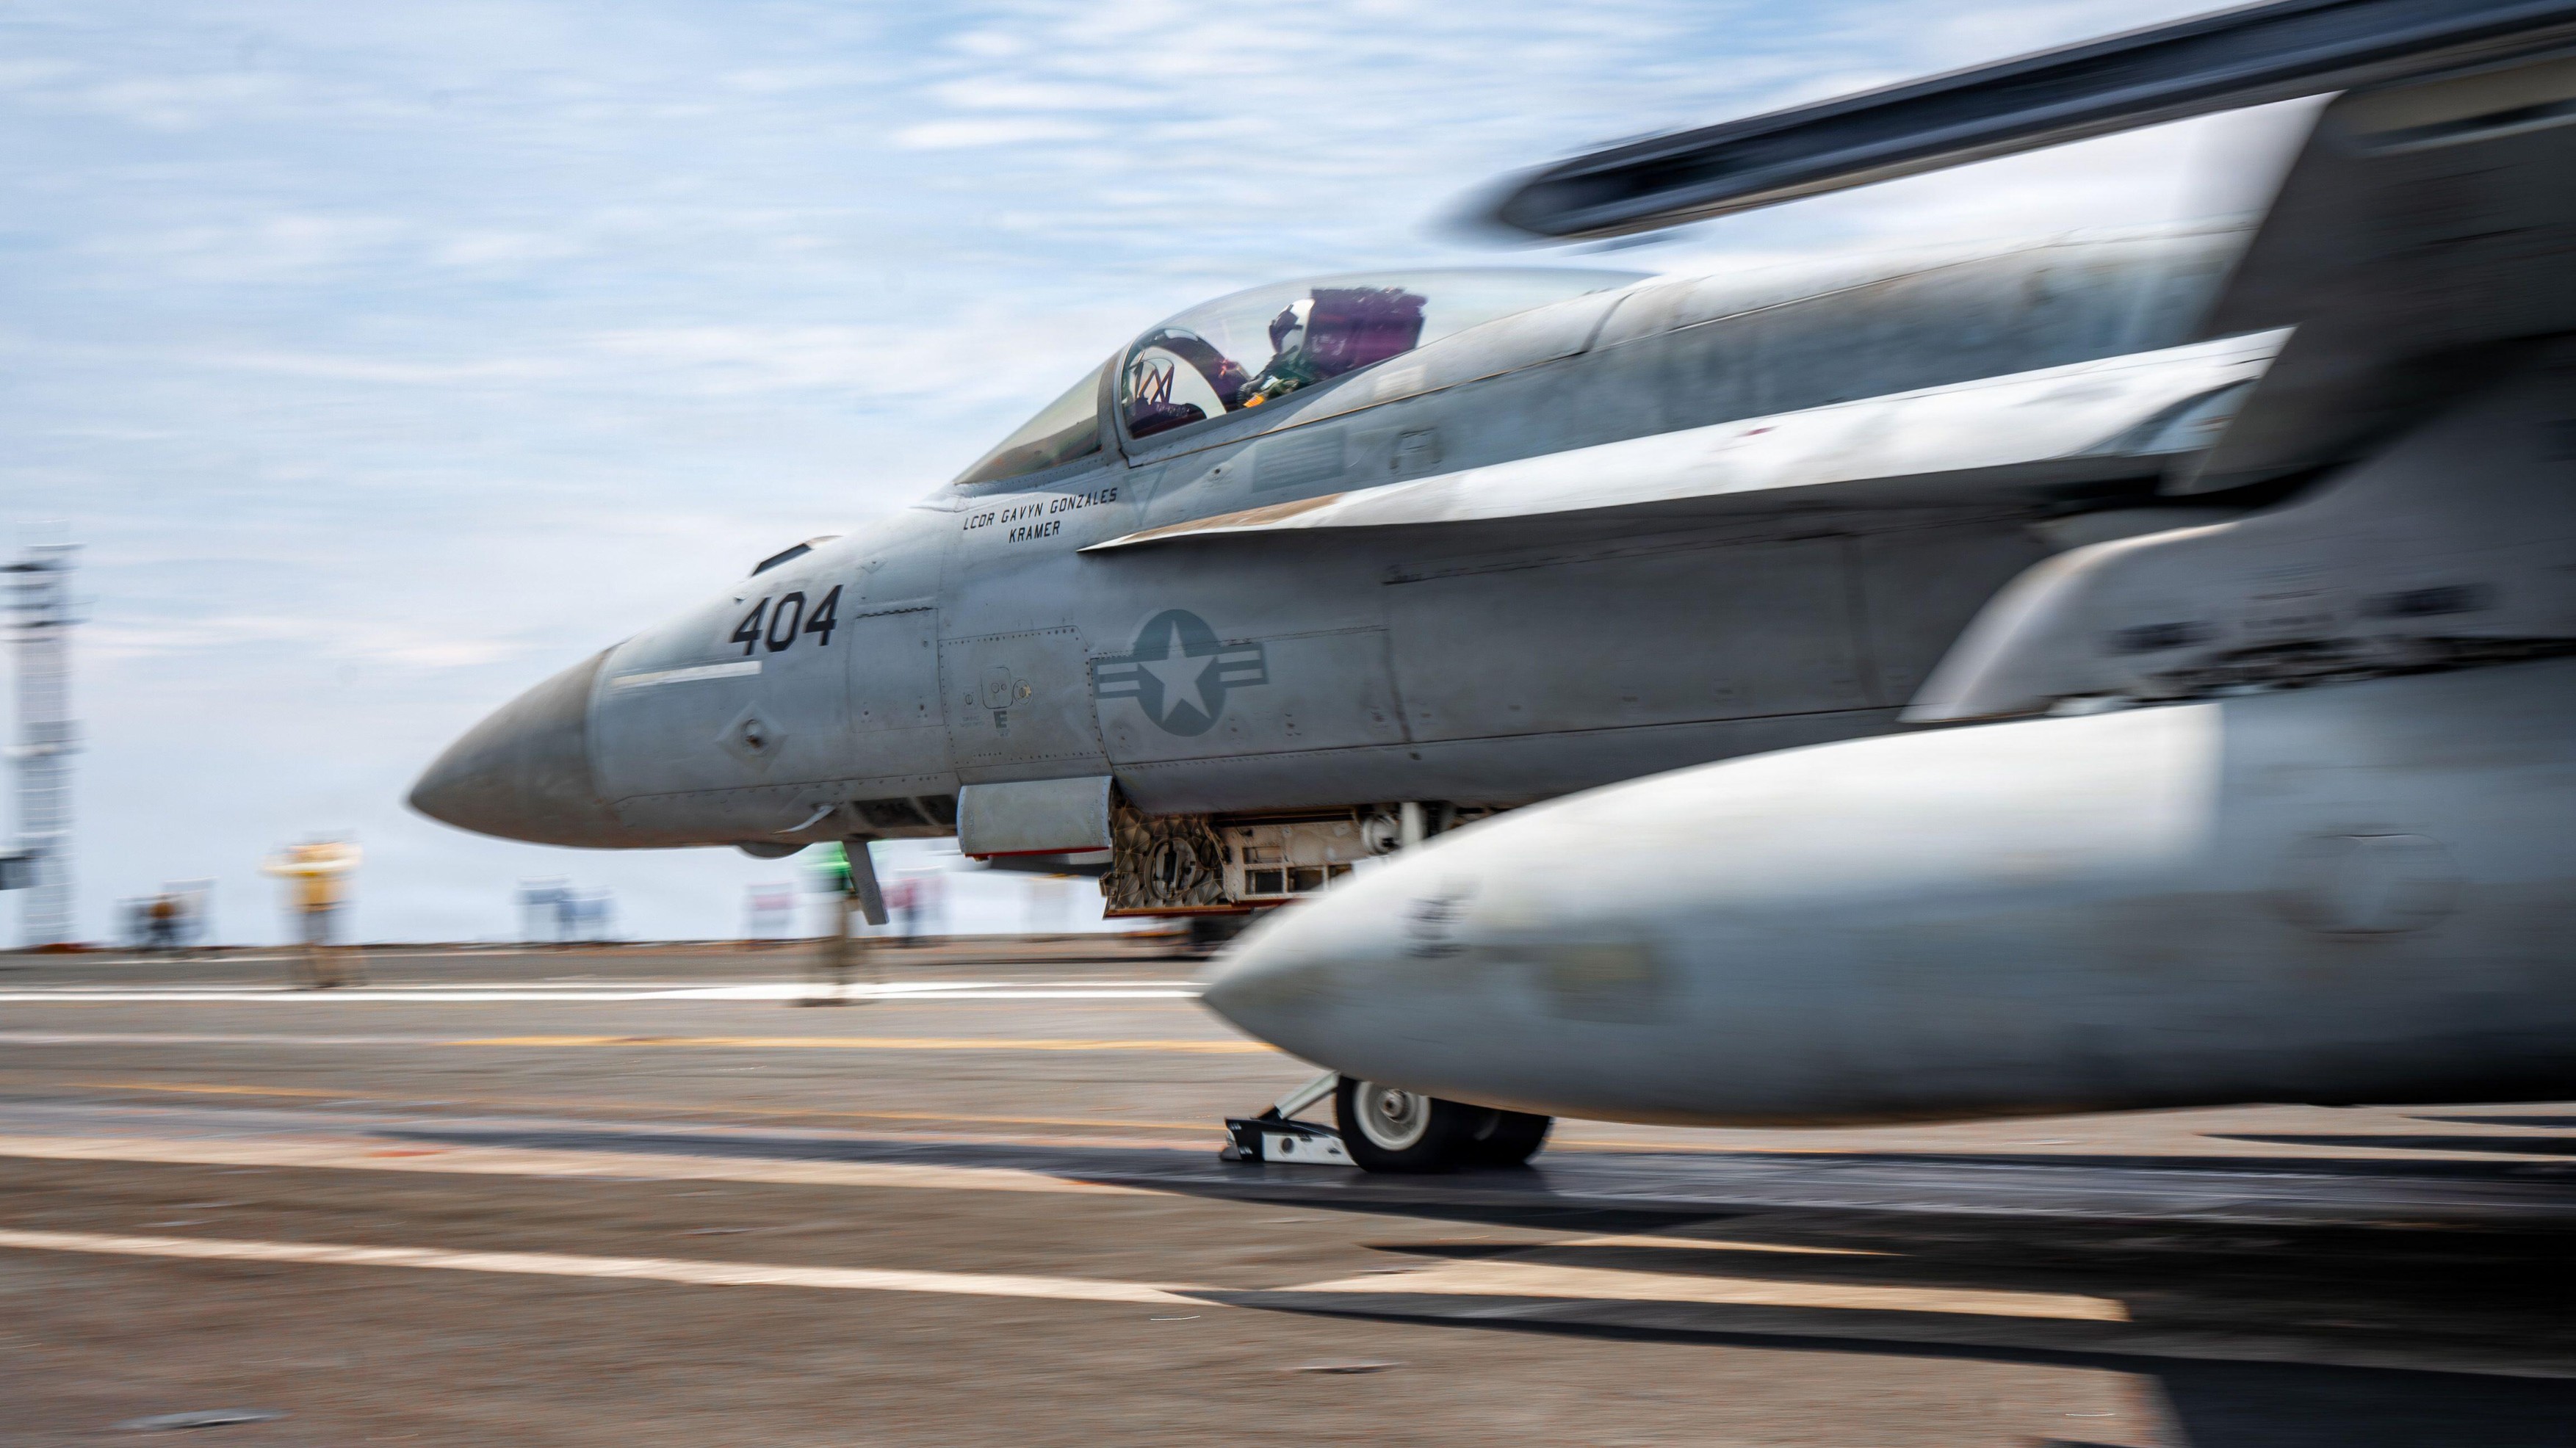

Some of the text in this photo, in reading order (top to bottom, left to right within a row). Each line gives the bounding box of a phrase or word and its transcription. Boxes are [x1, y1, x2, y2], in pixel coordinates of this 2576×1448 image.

[963, 488, 1118, 530] LCDR GAVYN GONZALES
[1009, 520, 1061, 543] KRAMER
[729, 584, 844, 656] 404
[993, 710, 1008, 729] E
